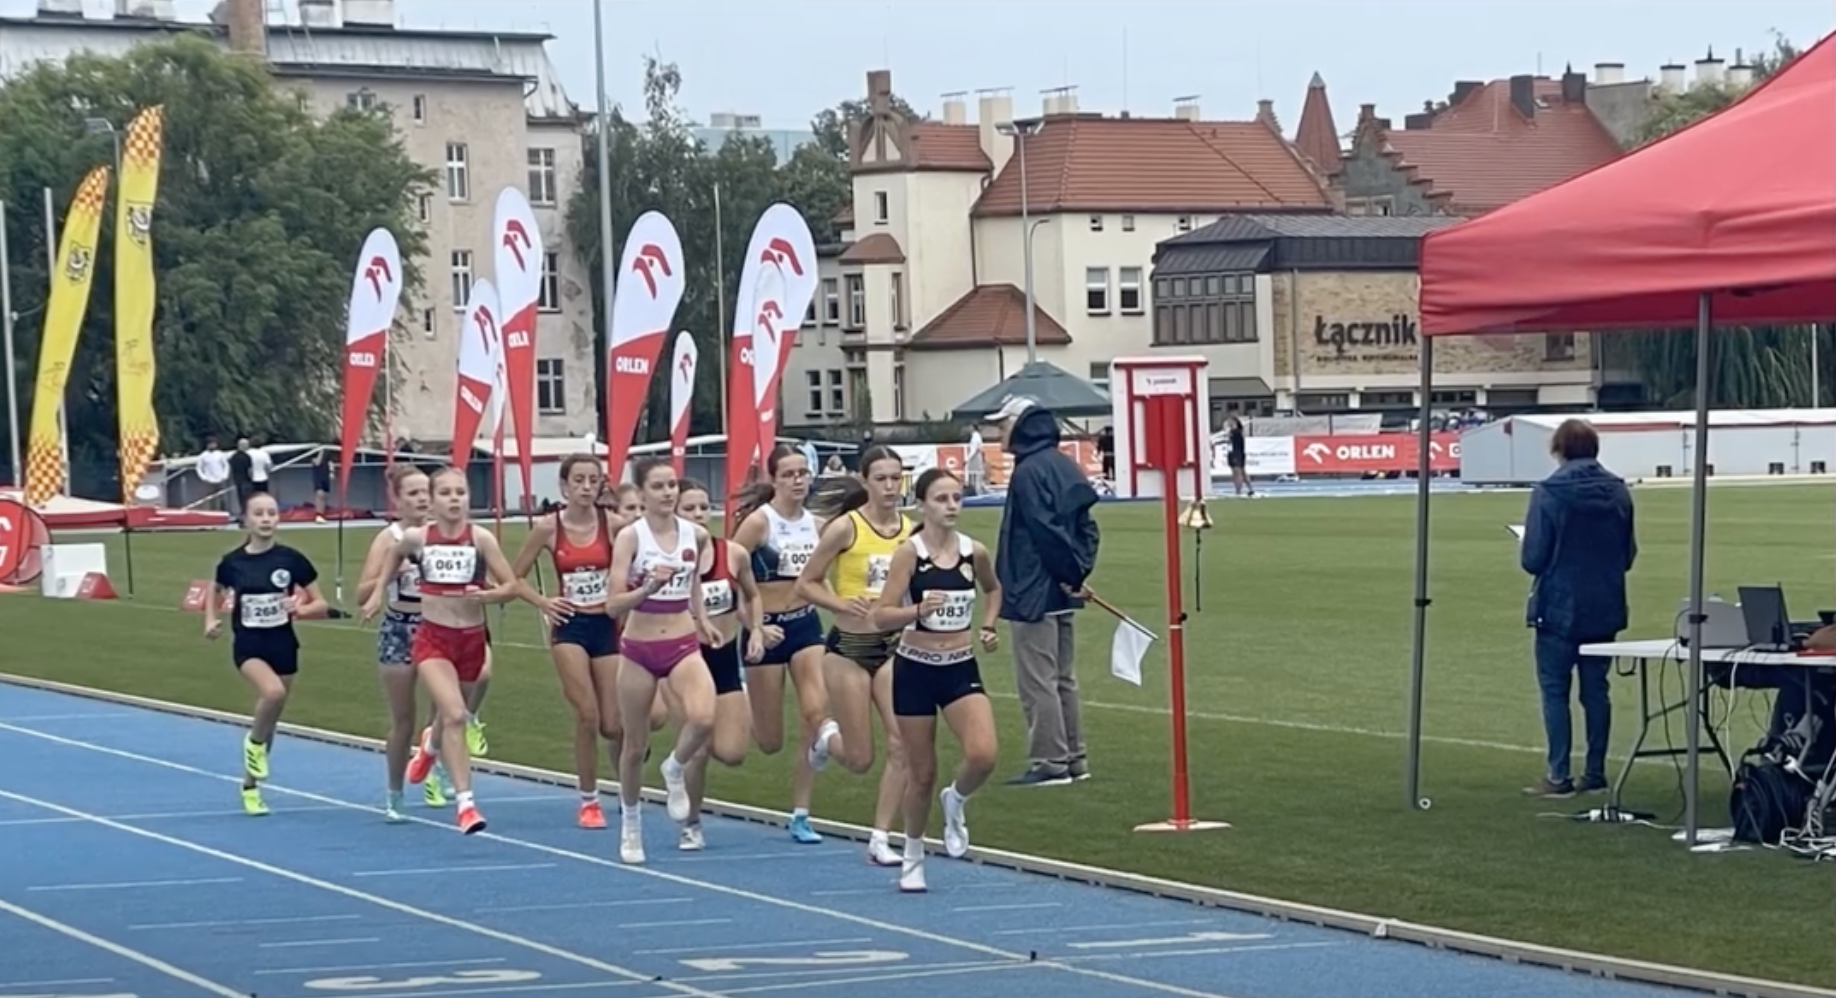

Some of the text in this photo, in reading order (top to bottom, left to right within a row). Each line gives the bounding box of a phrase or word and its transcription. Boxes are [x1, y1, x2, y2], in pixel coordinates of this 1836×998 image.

[1314, 314, 1417, 353] Łącznik
[615, 356, 648, 374] ORLEN
[1336, 444, 1395, 460] ORLEN
[436, 559, 462, 570] 061
[576, 583, 602, 595] 435
[936, 605, 965, 617] 083
[907, 648, 942, 662] PRO
